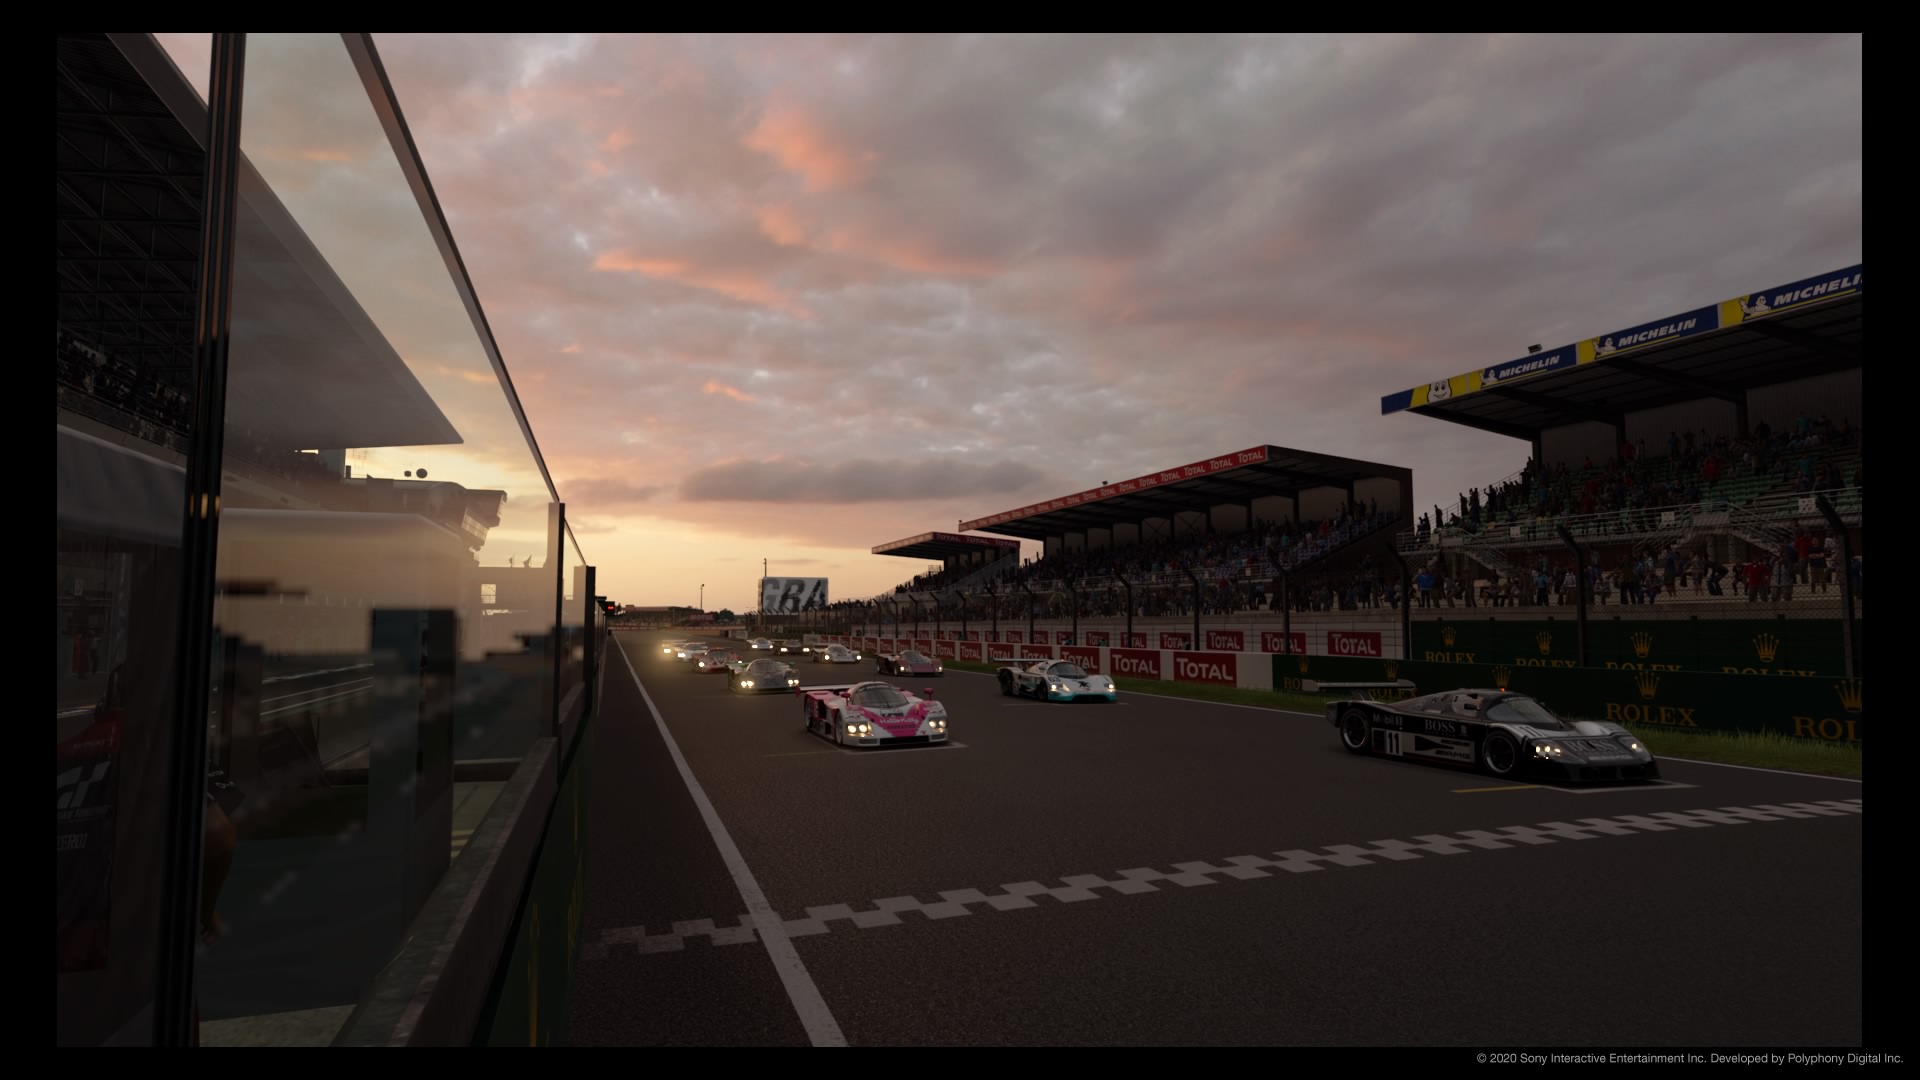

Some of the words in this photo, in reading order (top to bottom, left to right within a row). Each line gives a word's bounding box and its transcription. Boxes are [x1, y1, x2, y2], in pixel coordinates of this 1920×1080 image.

[1774, 274, 1862, 306] MICHELI
[1618, 317, 1697, 348] MICHELIN
[1499, 355, 1560, 379] MICHELIN
[1100, 487, 1116, 496] TOTAL
[1119, 482, 1137, 491] TOTAL
[1139, 477, 1158, 487] TOTAL
[1160, 471, 1181, 482] TOTAL
[1184, 466, 1206, 477] TOTAL
[1209, 458, 1233, 470] TOTAL
[1237, 450, 1264, 463] TOTAL
[936, 533, 960, 542] TOTAL
[965, 536, 990, 545] TOTAL
[994, 539, 1018, 548] TOTAL
[936, 644, 955, 657] TOTAL
[1122, 633, 1145, 648] TTAL
[1162, 633, 1185, 649] TOTA
[1209, 632, 1241, 650] TOTAL
[1332, 634, 1377, 655] TOTAL
[961, 646, 982, 659] TOTAL
[1424, 651, 1477, 664] ROLEX
[1112, 654, 1159, 675] TOTAL
[1176, 657, 1234, 681] TOTAL
[1424, 718, 1456, 733] BOSS
[1605, 703, 1697, 728] ROLEX
[1388, 732, 1399, 754] 11
